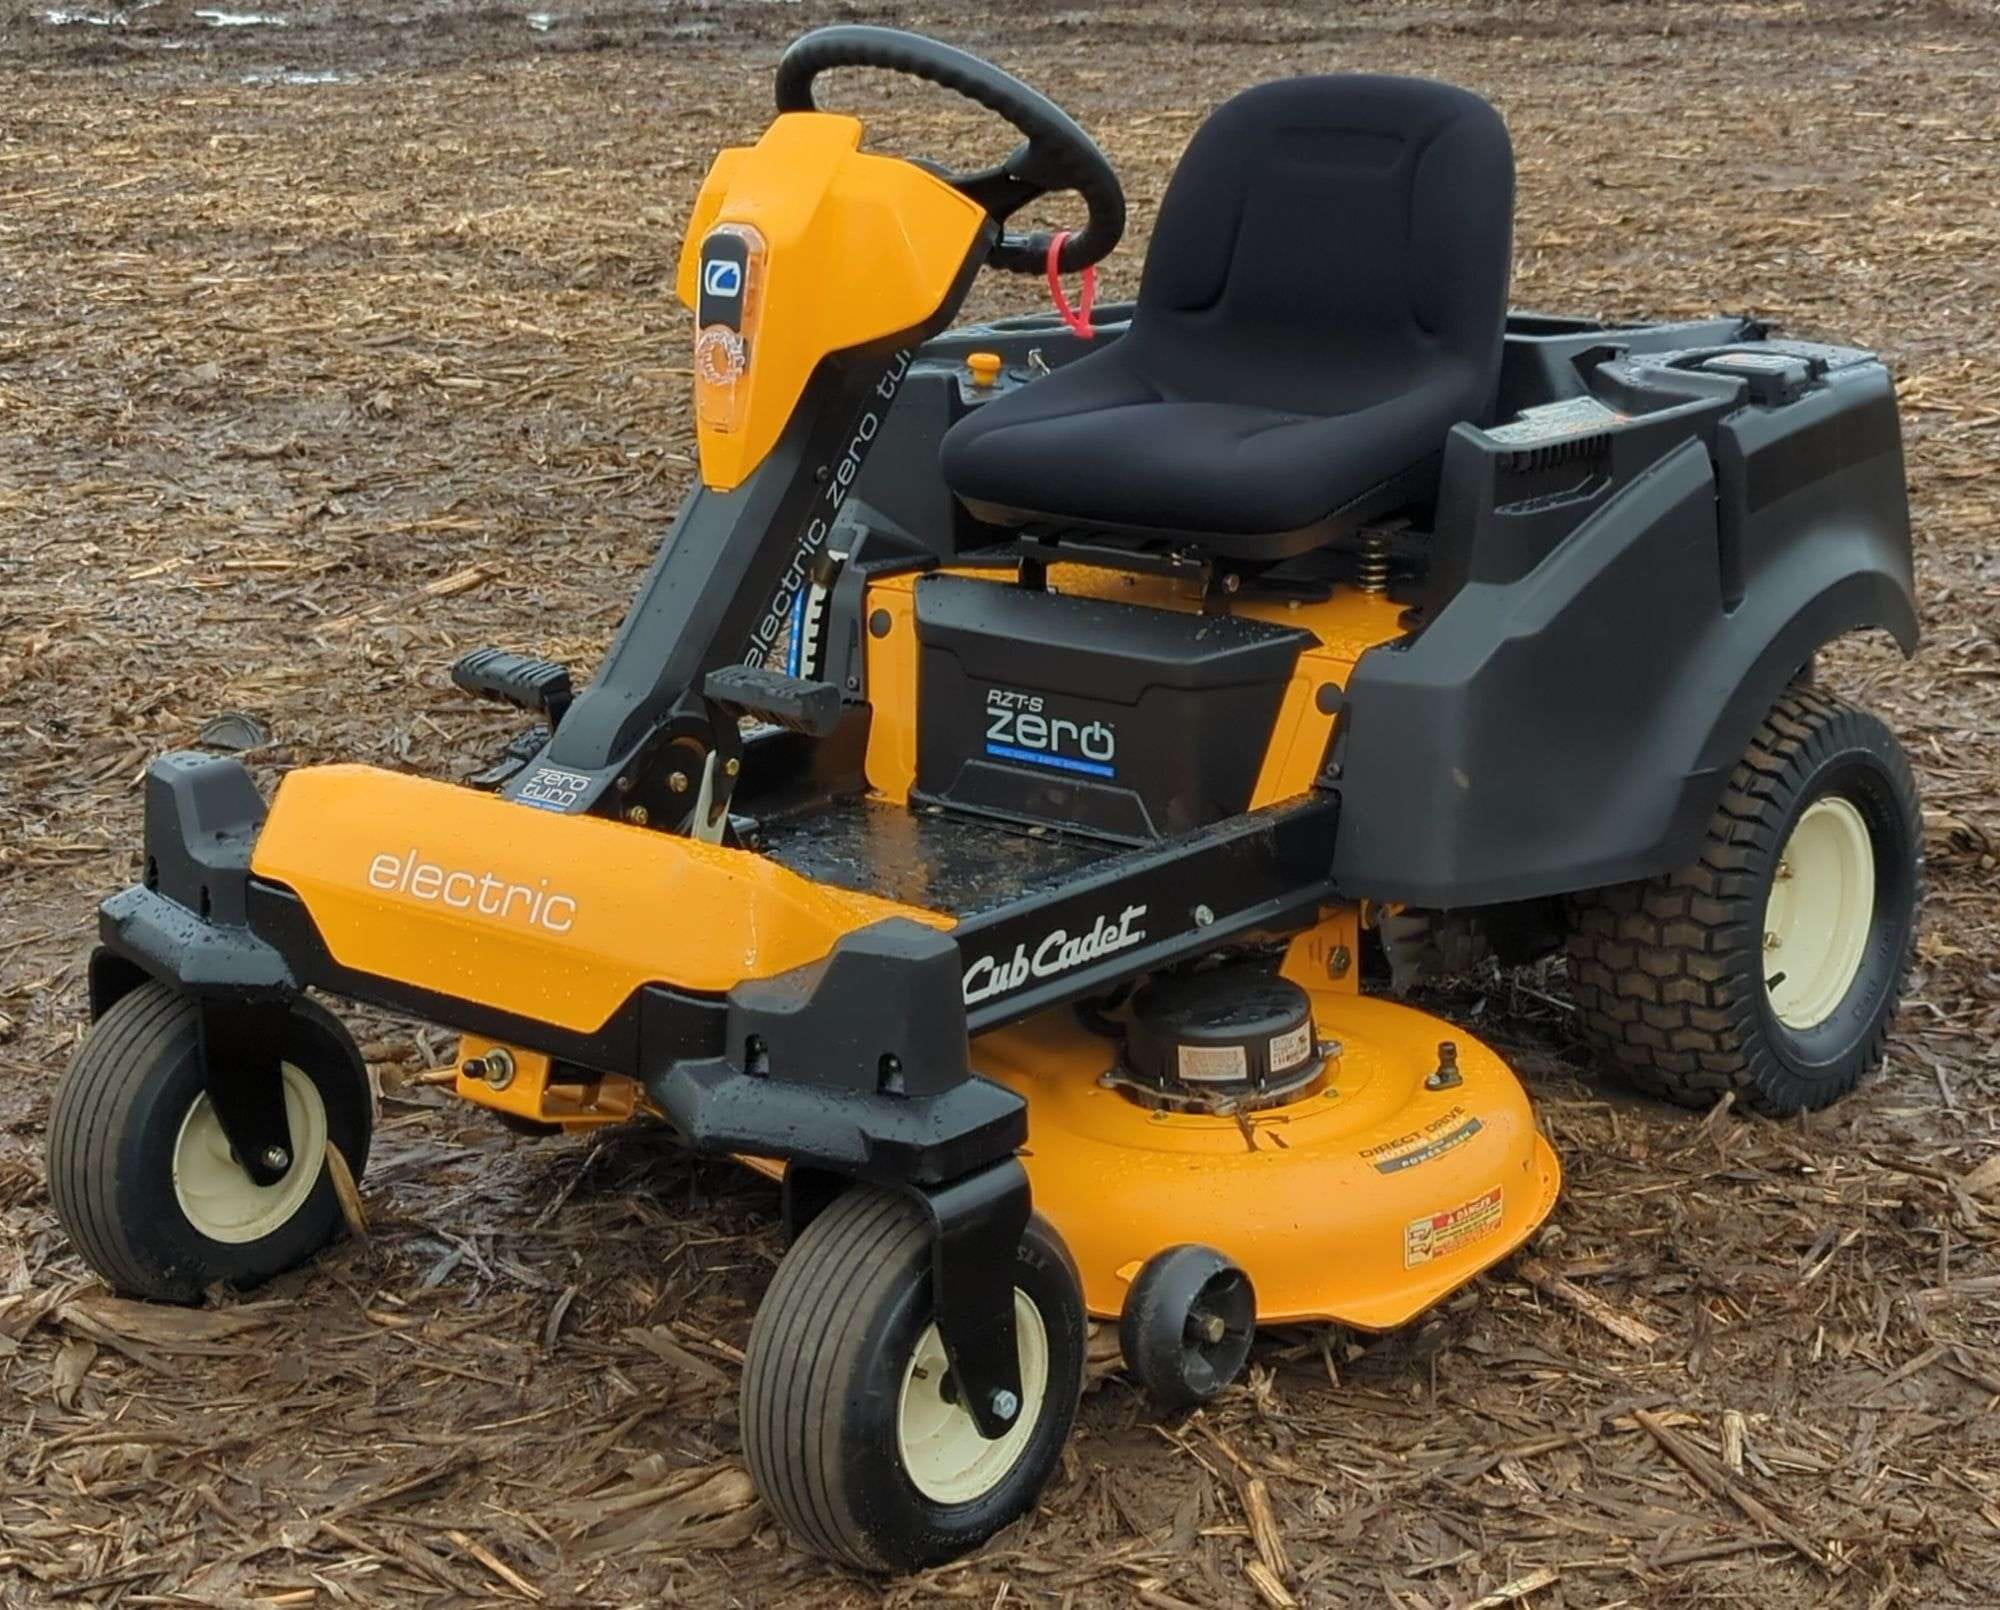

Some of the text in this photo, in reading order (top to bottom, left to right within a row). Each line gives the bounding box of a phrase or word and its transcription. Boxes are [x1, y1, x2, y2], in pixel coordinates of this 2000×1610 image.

[744, 518, 826, 669] electric
[826, 412, 878, 509] zero
[987, 689, 1044, 712] RZT-S
[522, 782, 577, 806] turn
[531, 769, 589, 791] zero
[368, 849, 576, 931] electric
[962, 904, 1147, 1005] Cub Cadet
[1359, 1131, 1422, 1158] DIRECT
[1425, 1105, 1466, 1133] DRIVE
